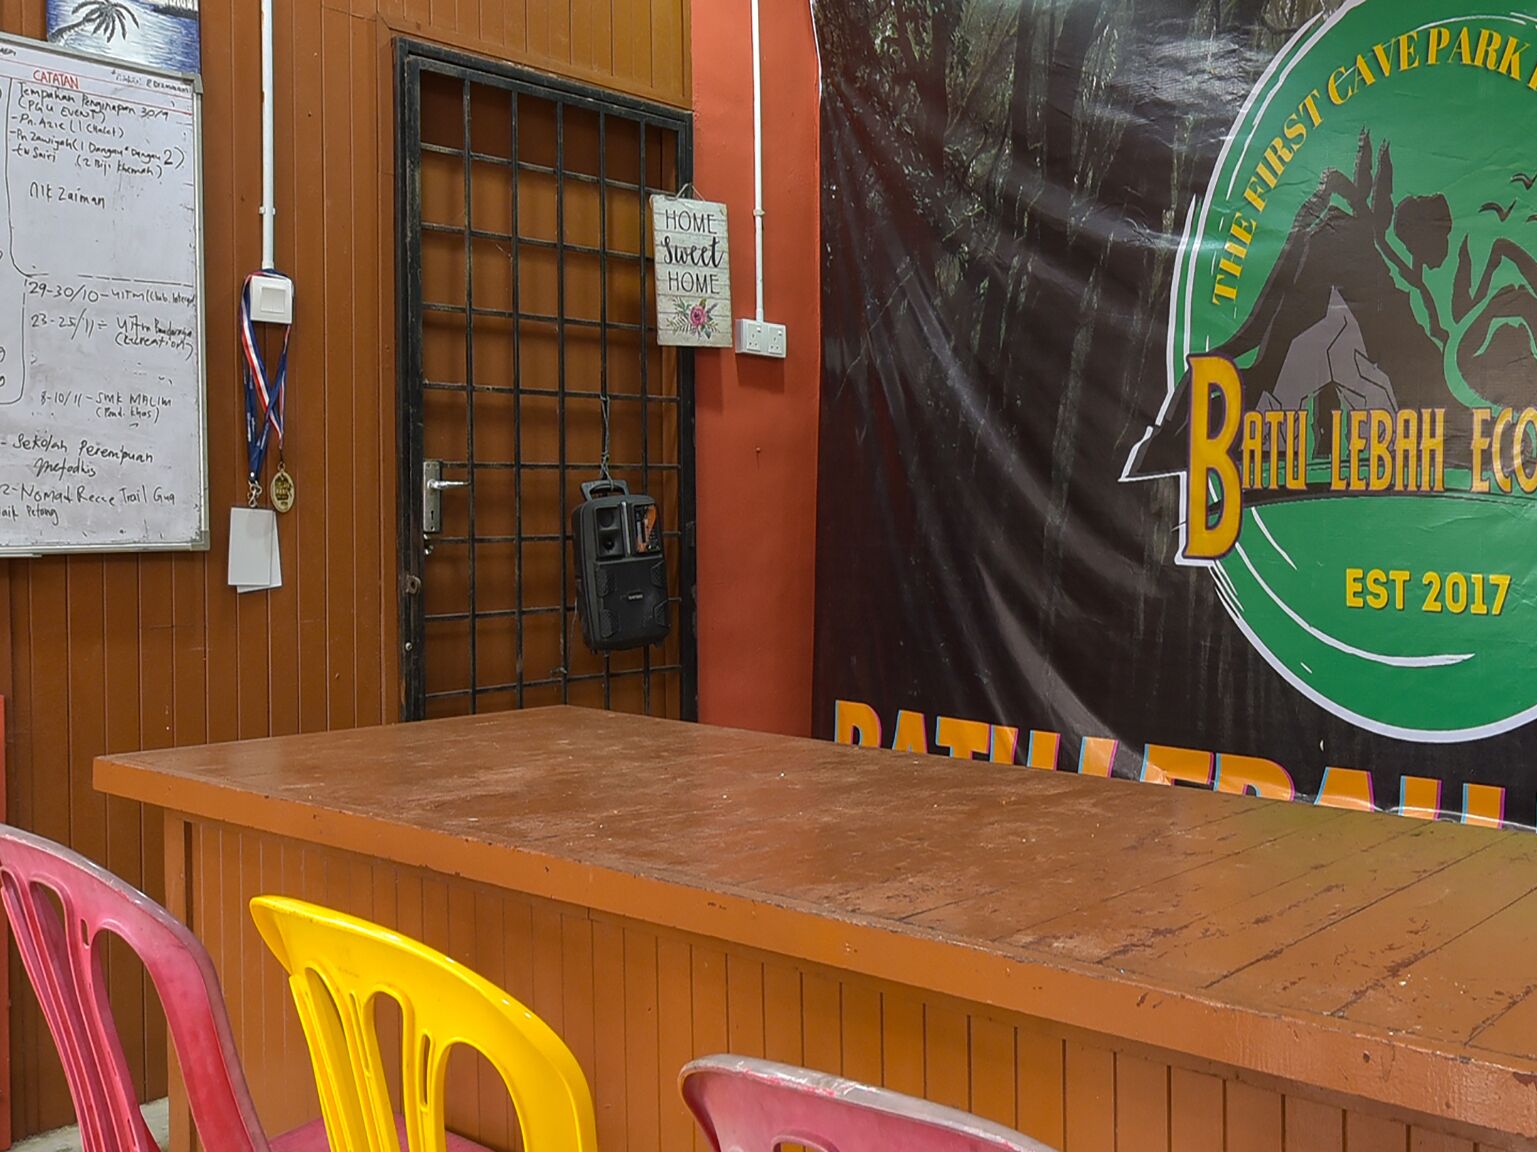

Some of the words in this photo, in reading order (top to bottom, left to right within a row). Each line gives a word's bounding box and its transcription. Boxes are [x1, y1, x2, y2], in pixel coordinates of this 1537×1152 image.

[33, 70, 80, 89] CATATAN
[1212, 212, 1257, 305] THE
[1243, 89, 1325, 214] FIRST
[1327, 30, 1420, 105] CAVE
[1426, 26, 1532, 81] PARK
[665, 209, 717, 235] HOME
[661, 235, 724, 268] Sweet
[667, 271, 720, 295] HOME
[1182, 353, 1308, 559] BATU
[1330, 406, 1445, 493] LEBAH
[1345, 568, 1411, 609] EST
[1423, 571, 1511, 616] 2017
